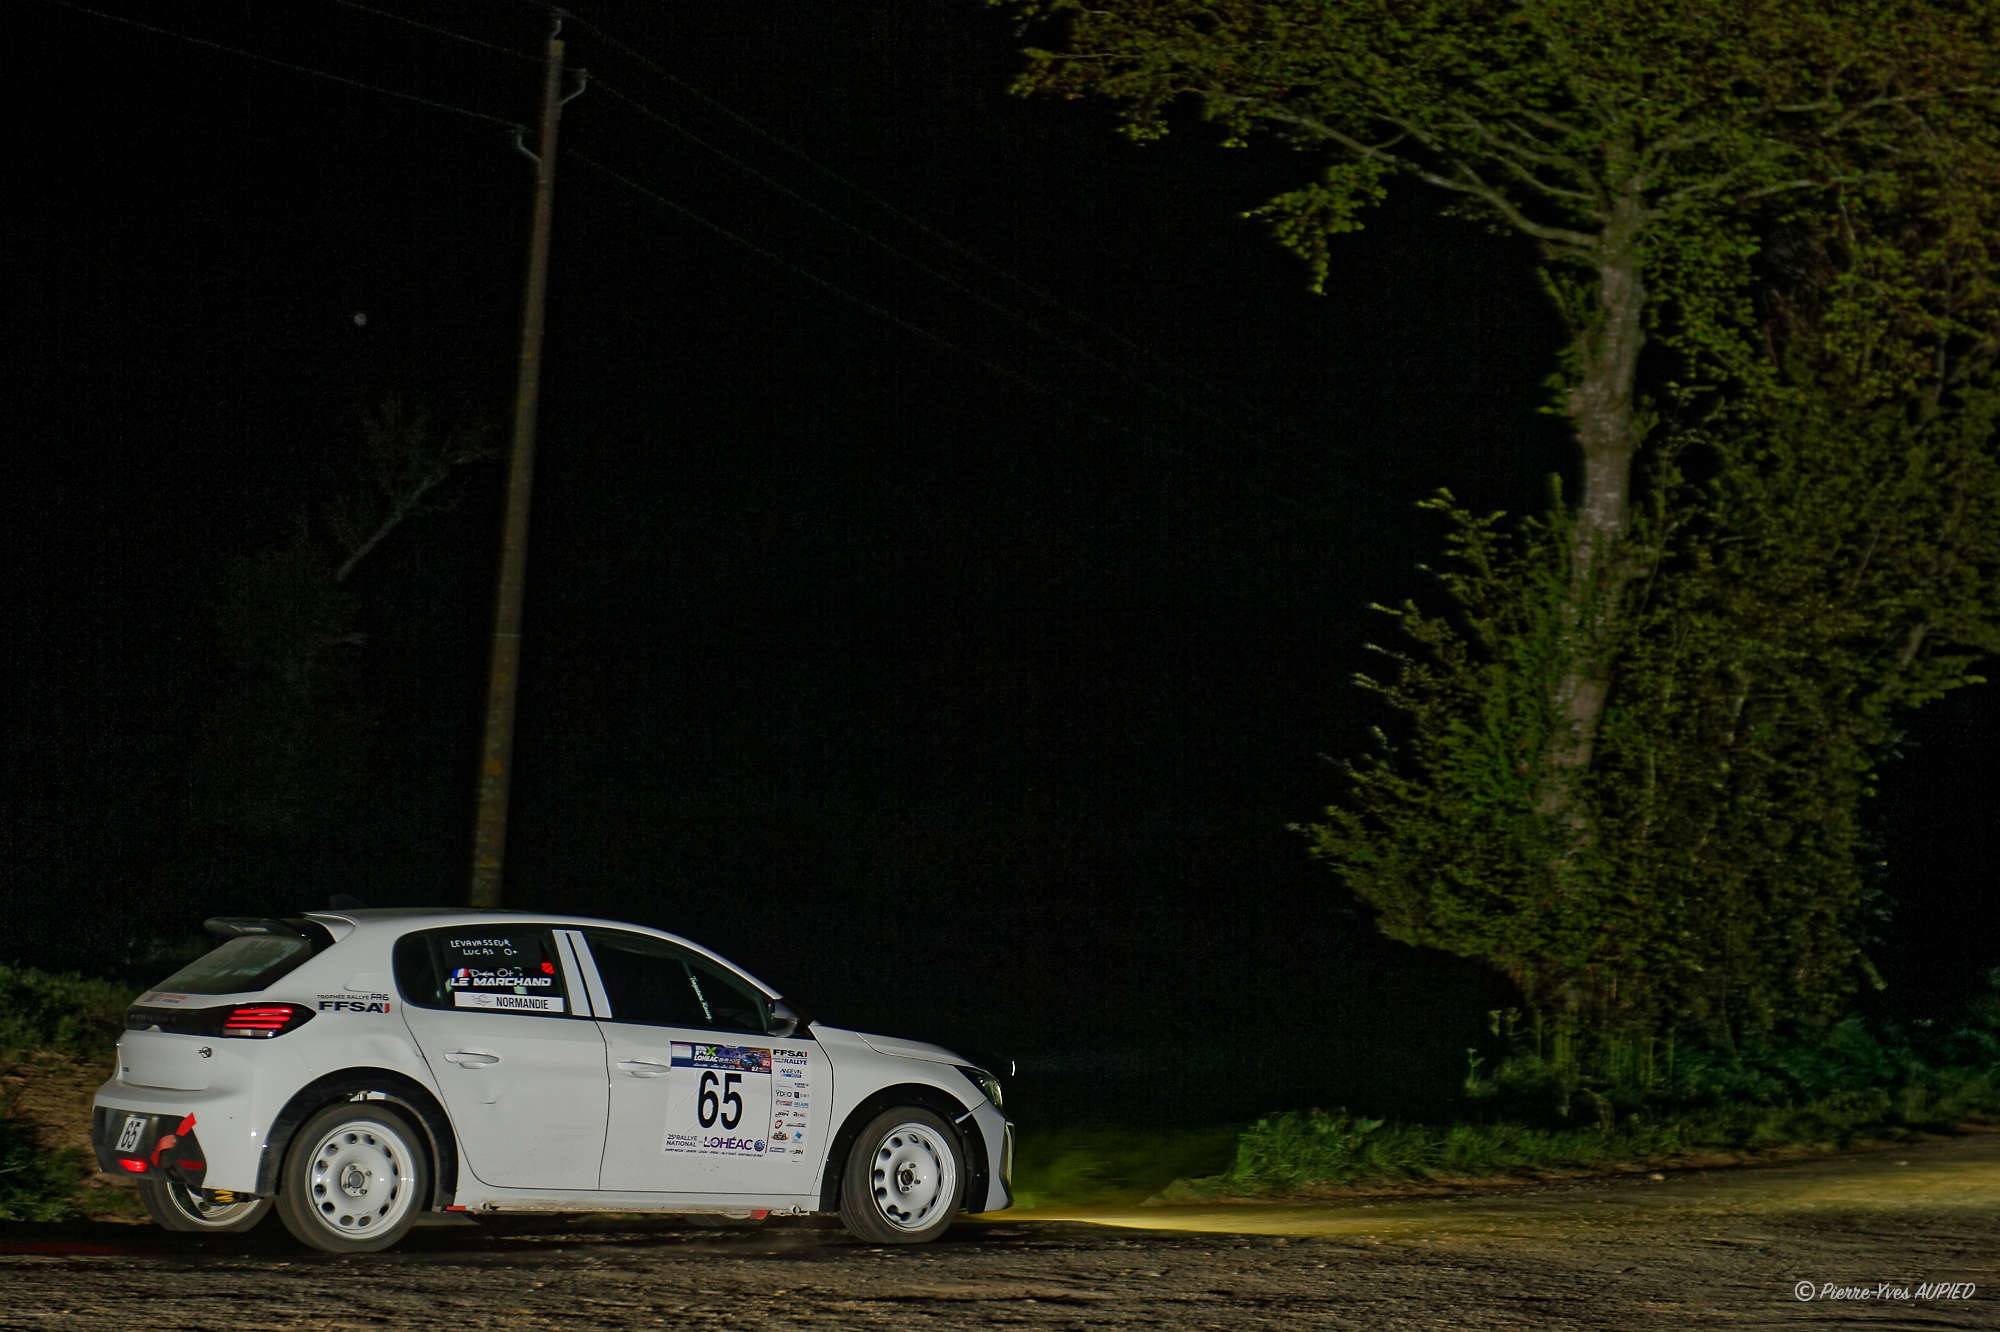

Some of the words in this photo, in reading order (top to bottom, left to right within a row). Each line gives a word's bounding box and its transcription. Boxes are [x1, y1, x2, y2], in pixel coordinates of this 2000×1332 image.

[450, 939, 511, 948] LEVAVASSEUR
[463, 948, 494, 956] LUCAS
[450, 977, 469, 986] LE
[472, 977, 552, 987] MARCHAND
[318, 1001, 384, 1014] FFSA
[496, 996, 549, 1010] NORMANDIE
[773, 1048, 804, 1058] FFSA
[783, 1058, 808, 1066] RALLYE
[698, 1070, 743, 1131] 65
[120, 1120, 141, 1149] 65
[676, 1134, 698, 1142] RALLYE
[666, 1140, 697, 1148] NATIONAL
[703, 1136, 754, 1151] LOHÉAC
